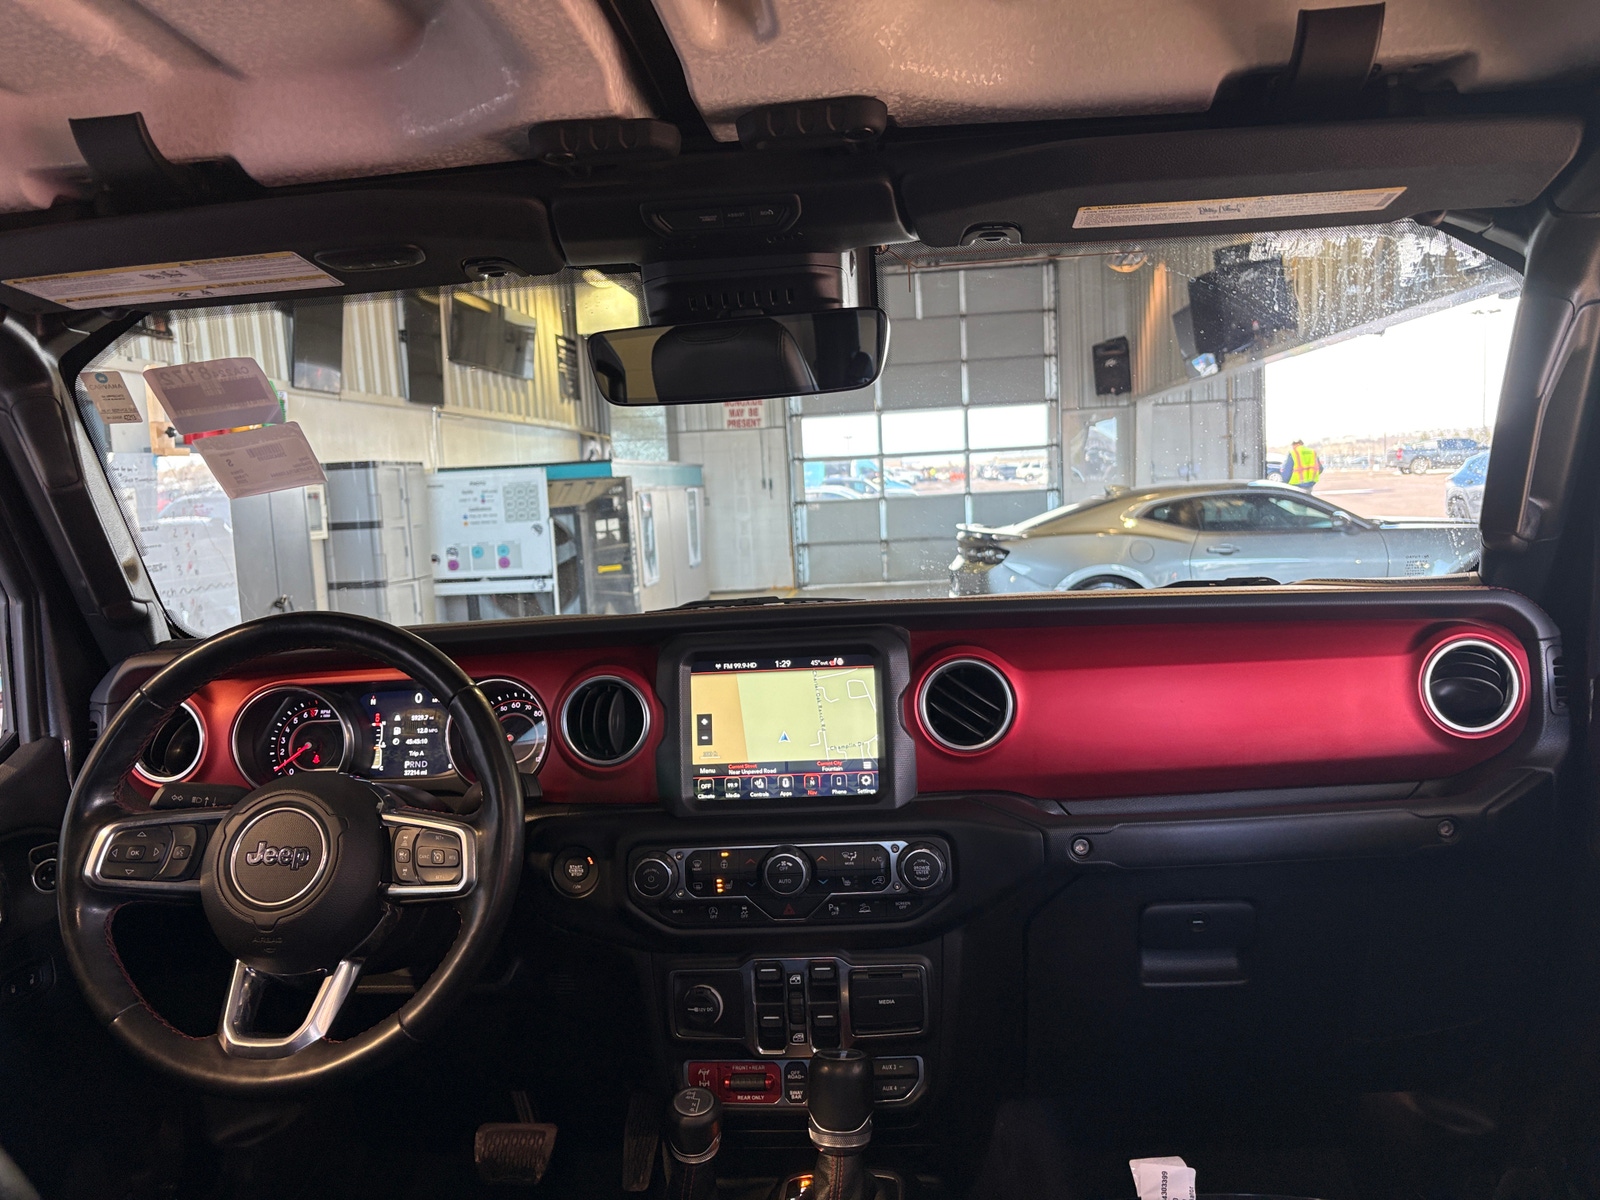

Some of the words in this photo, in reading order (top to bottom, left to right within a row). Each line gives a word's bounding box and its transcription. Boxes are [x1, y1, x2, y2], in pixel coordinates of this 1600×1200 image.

[728, 408, 744, 418] MAY
[748, 407, 759, 417] BE
[726, 418, 762, 428] PRESENT
[774, 659, 792, 668] 1:29
[414, 692, 423, 704] 0
[511, 701, 521, 709] 60
[303, 711, 309, 719] 6
[293, 716, 298, 724] 5
[280, 748, 285, 756] 2
[288, 767, 294, 776] 0
[246, 841, 311, 871] Jeep
